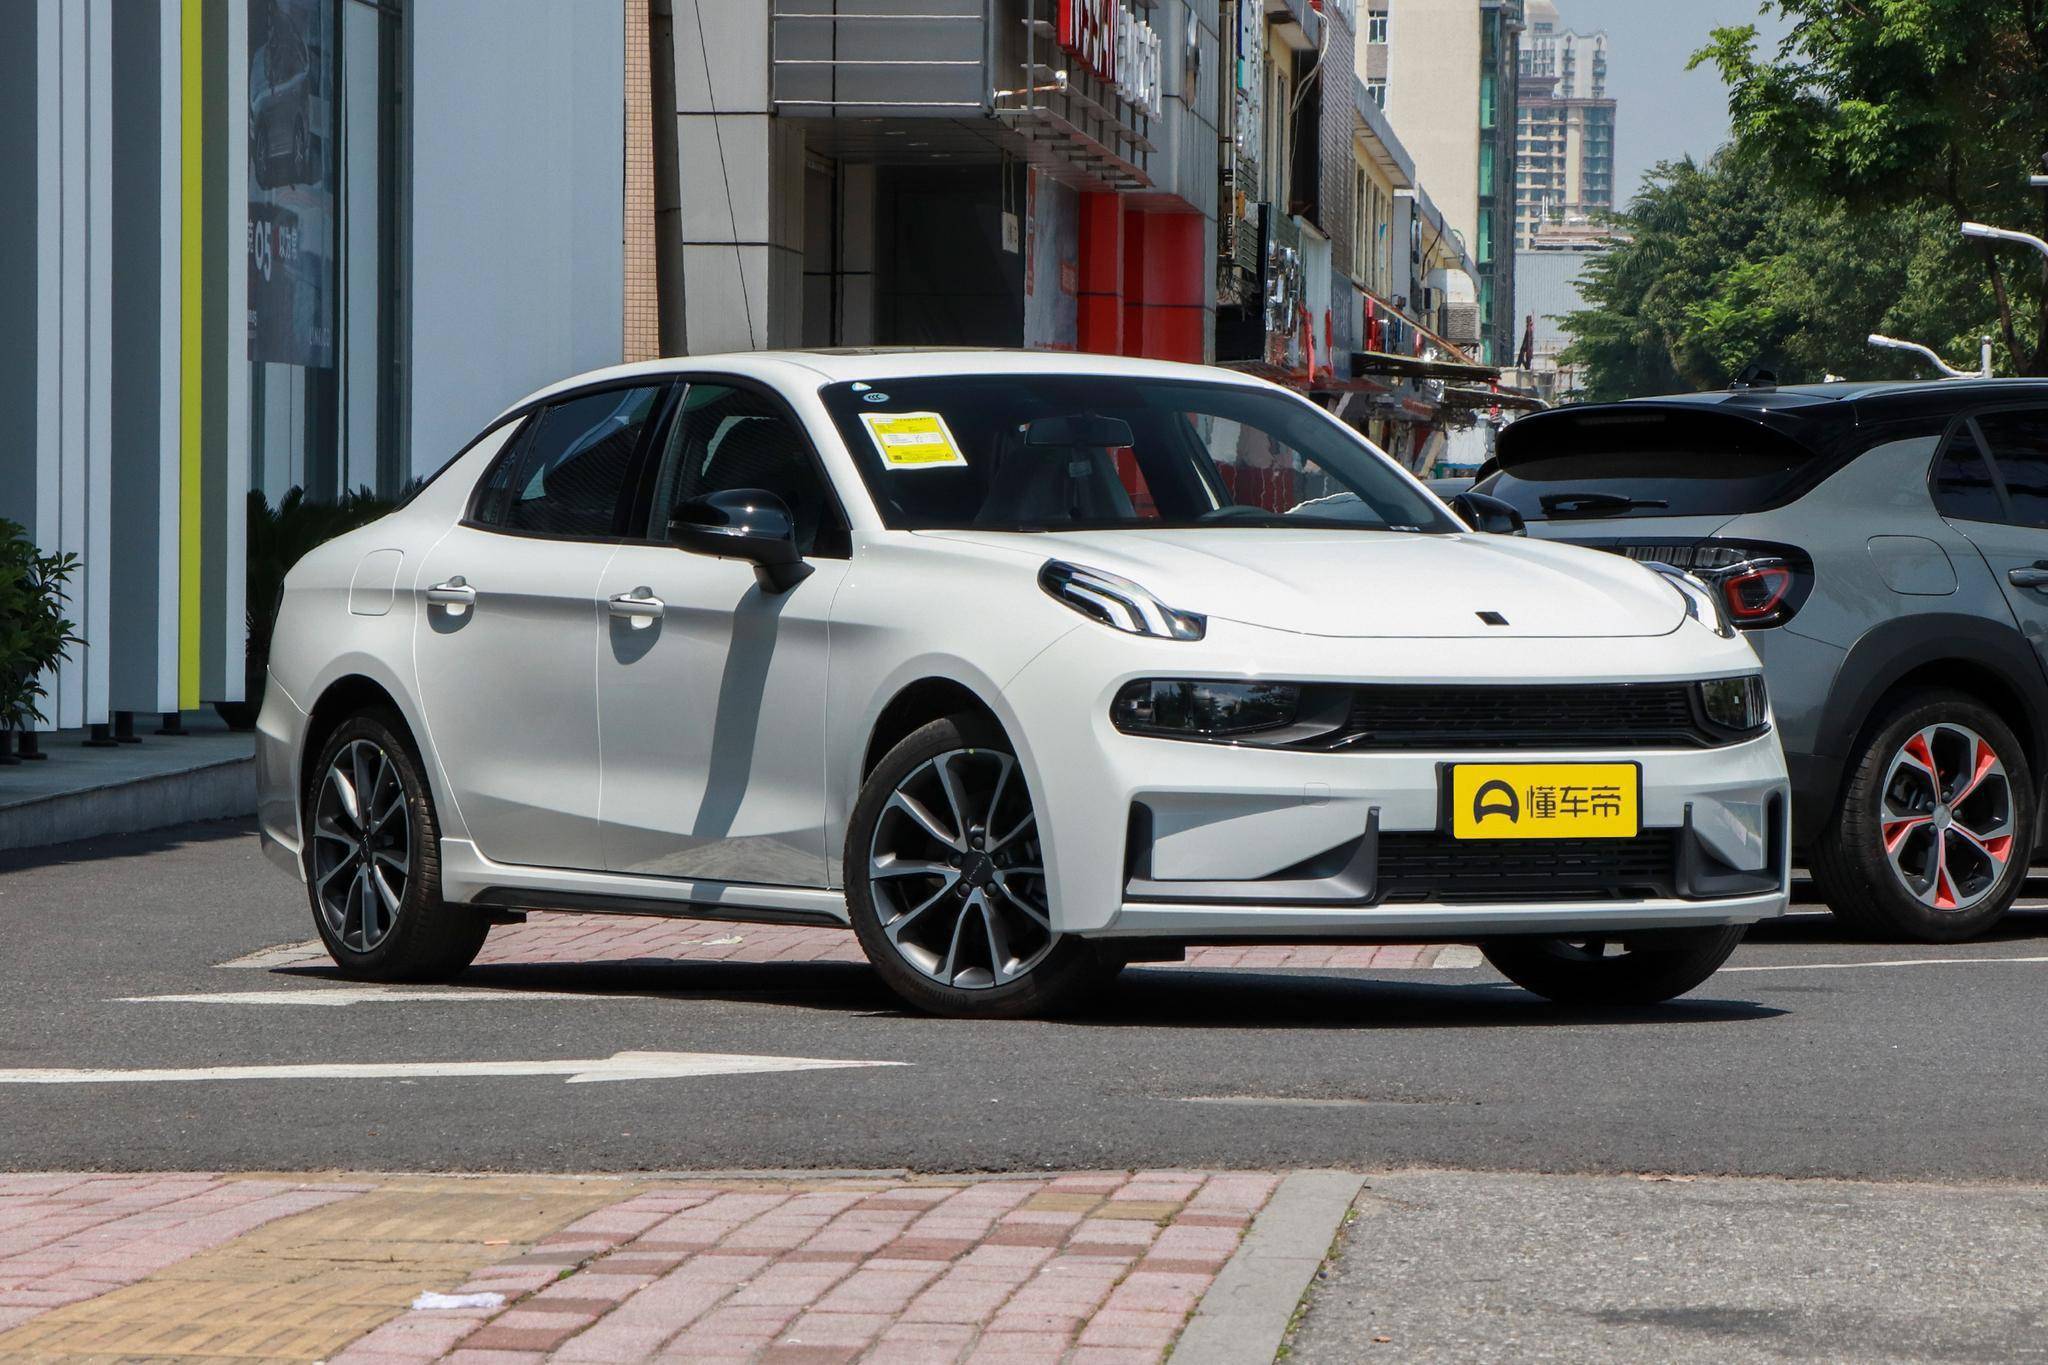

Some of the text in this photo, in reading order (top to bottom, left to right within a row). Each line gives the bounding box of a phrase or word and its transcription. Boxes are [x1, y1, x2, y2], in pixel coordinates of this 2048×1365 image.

[255, 220, 272, 283] 05
[1526, 785, 1621, 819] 懂车帝
